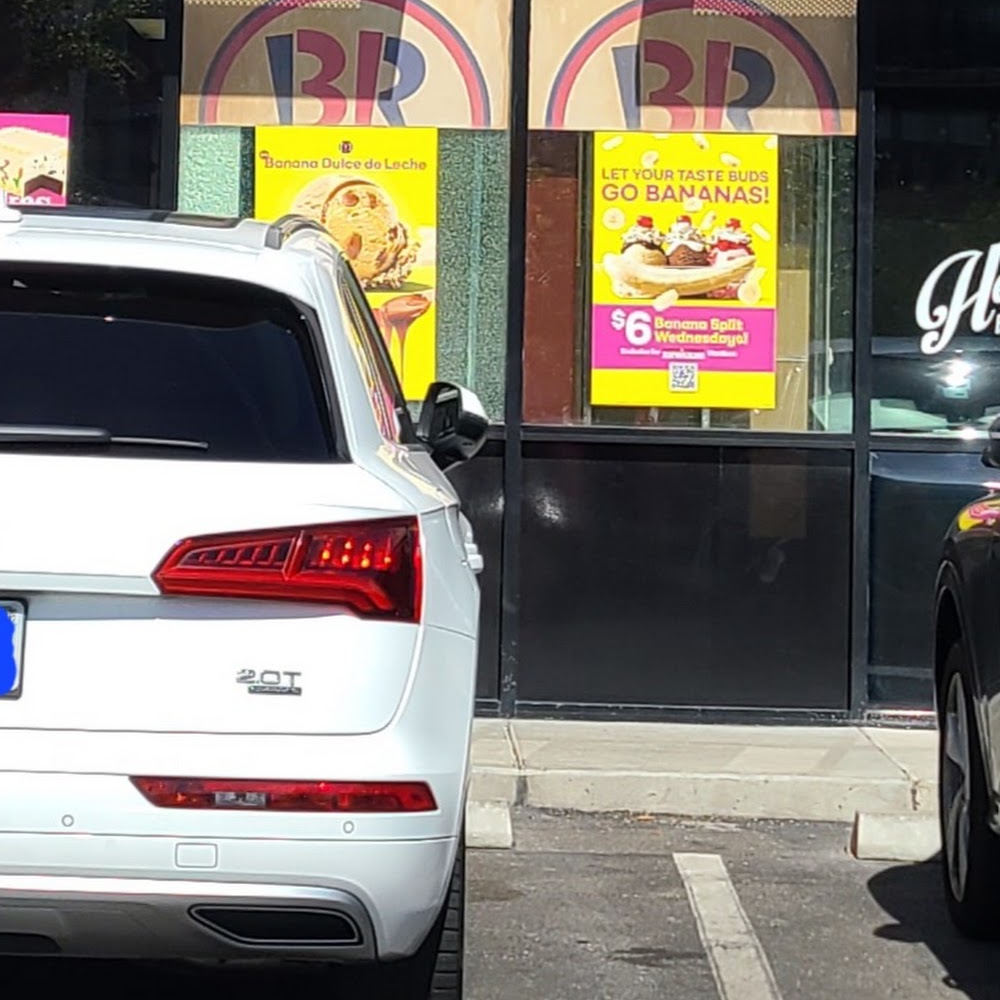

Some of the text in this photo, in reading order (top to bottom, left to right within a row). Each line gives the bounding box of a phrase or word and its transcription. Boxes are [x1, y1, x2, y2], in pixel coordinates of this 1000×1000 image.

[265, 29, 426, 126] BR
[611, 39, 776, 131] BR
[264, 157, 427, 170] Banana Dulce de Leche
[602, 168, 769, 183] LET YOUR TASTE BUDS
[601, 183, 769, 204] GO BANANAS!
[611, 308, 744, 346] $6 Banana Split
[236, 669, 302, 688] 2.0T
